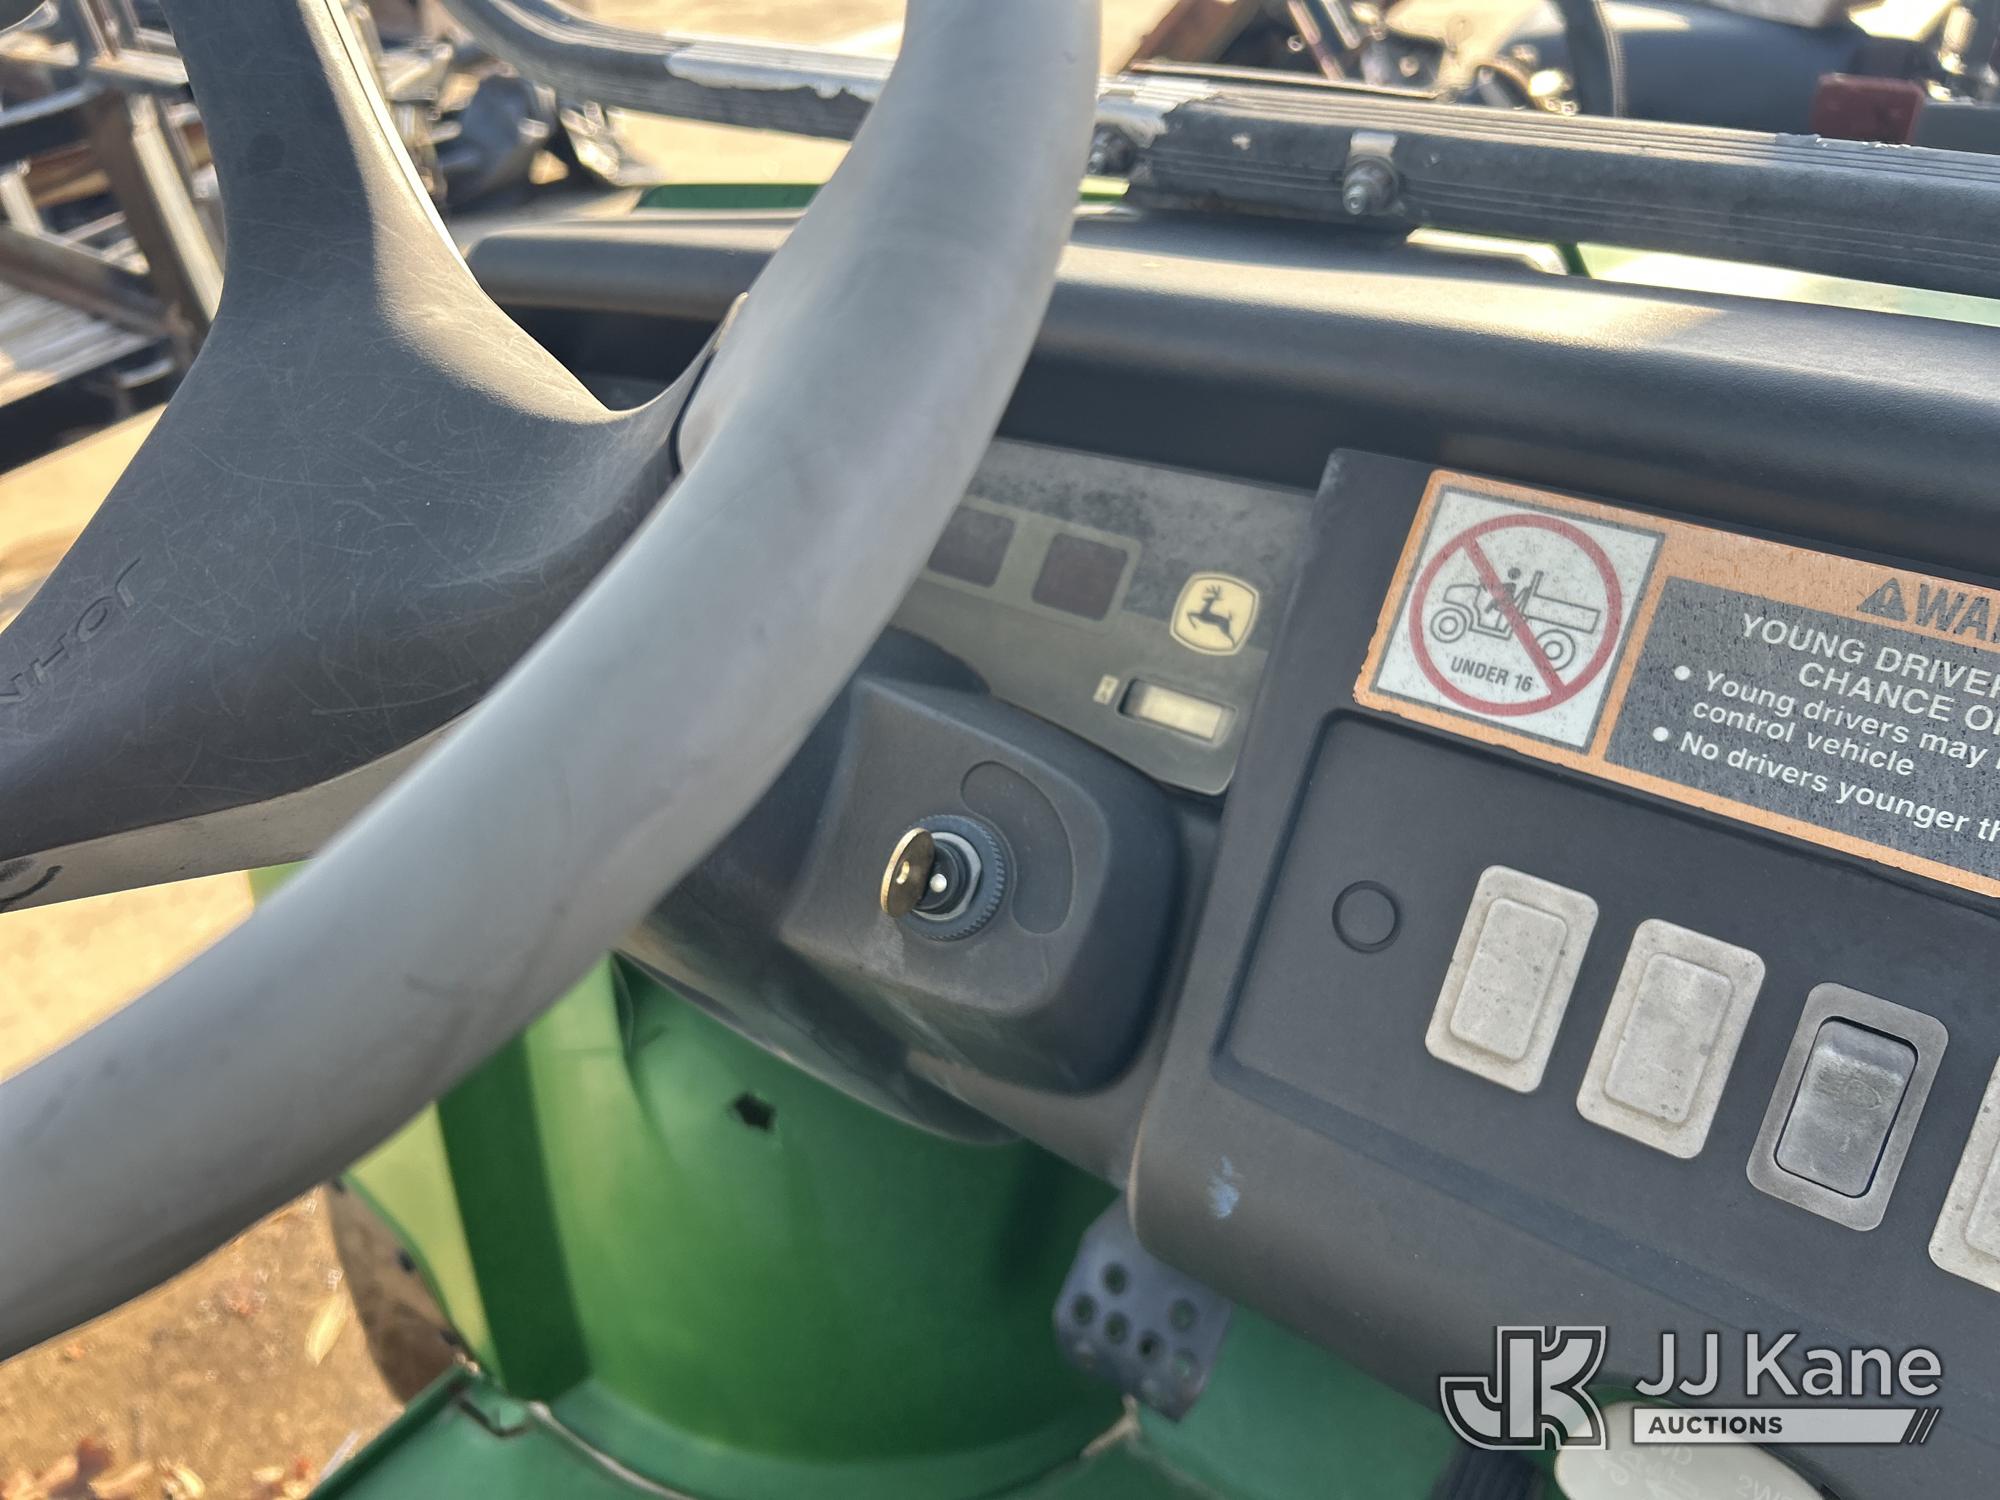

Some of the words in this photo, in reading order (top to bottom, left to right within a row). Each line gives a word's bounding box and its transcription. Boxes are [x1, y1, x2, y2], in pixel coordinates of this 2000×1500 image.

[1741, 613, 1866, 664] YOUNG
[1914, 583, 2000, 643] WA
[1450, 656, 1509, 686] UNDER
[1515, 673, 1533, 692] 16
[1798, 662, 1955, 722] CHANCE
[1965, 703, 2000, 736] O
[1693, 701, 1796, 743] control
[1806, 732, 1915, 776] vehicle
[1706, 670, 1796, 717] Young
[1803, 700, 1909, 744] drivers
[1918, 732, 1989, 769] may
[1680, 731, 1719, 761] No
[1727, 748, 1829, 792] drivers
[1836, 781, 1970, 832] younger
